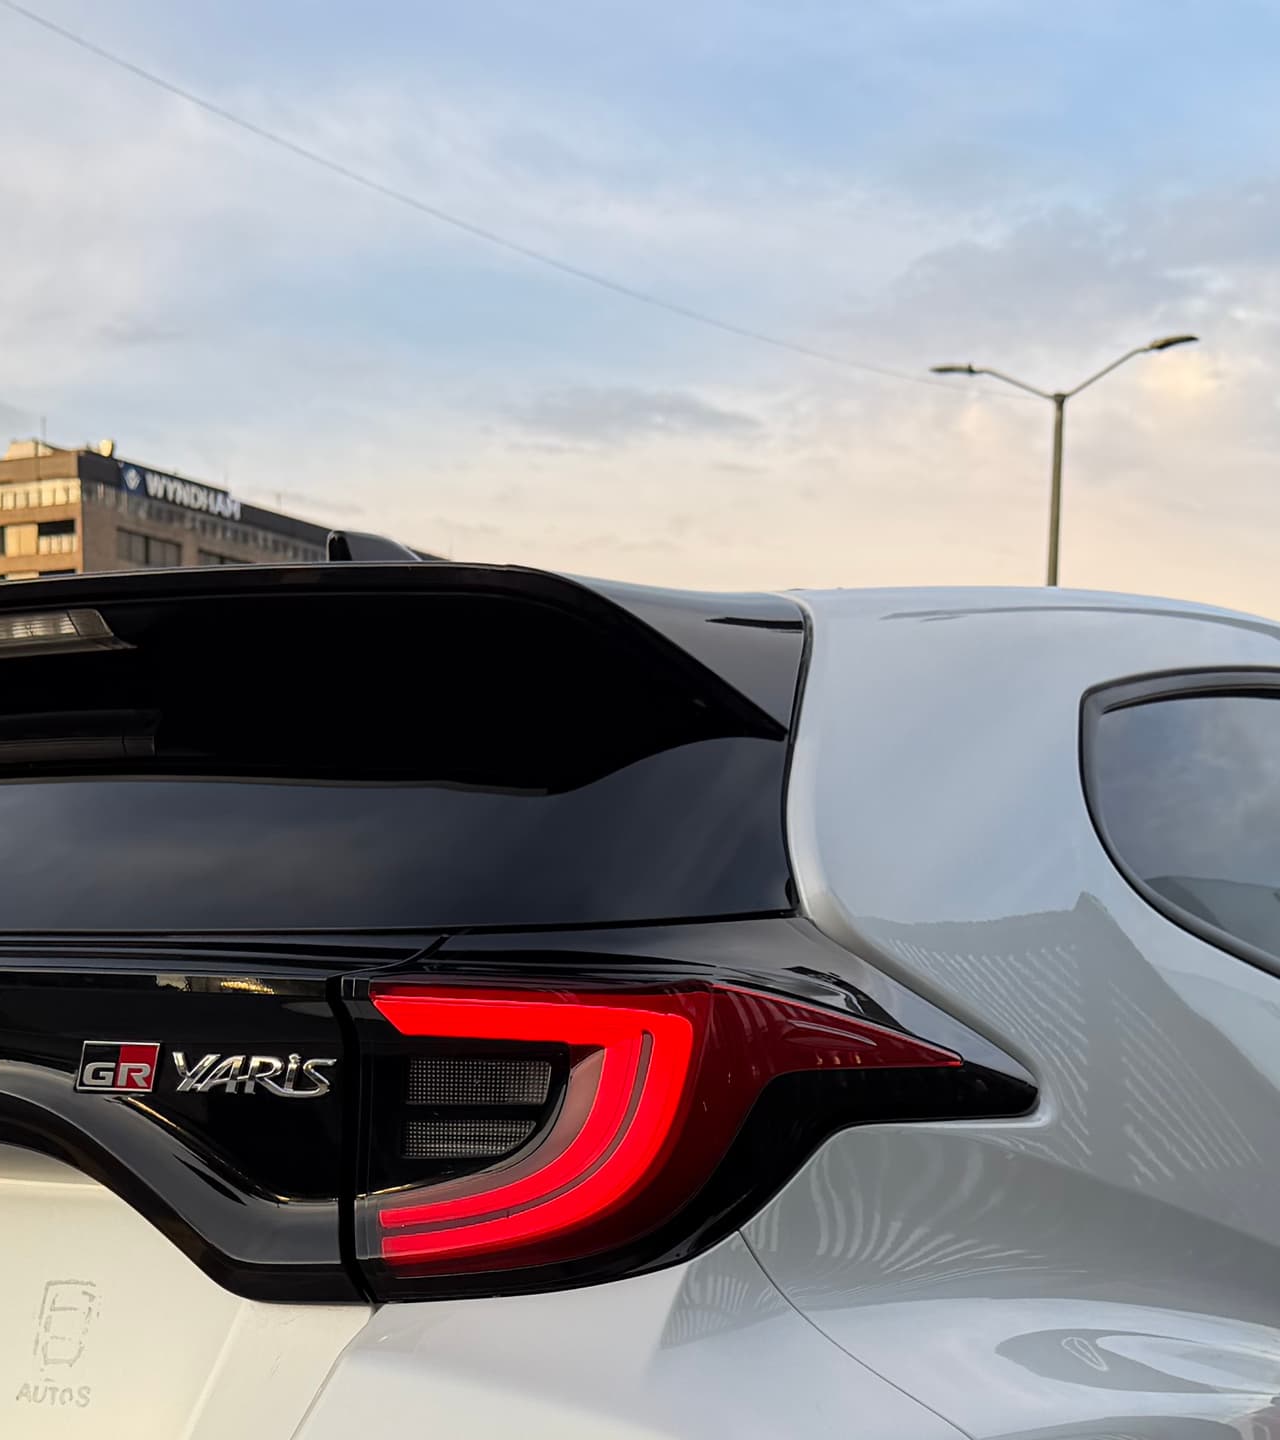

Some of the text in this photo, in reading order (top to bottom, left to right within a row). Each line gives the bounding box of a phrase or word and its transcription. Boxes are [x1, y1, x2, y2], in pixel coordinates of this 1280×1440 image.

[145, 472, 241, 520] WYNDHAM
[81, 1060, 153, 1089] GR
[15, 1382, 92, 1409] AUTOS
